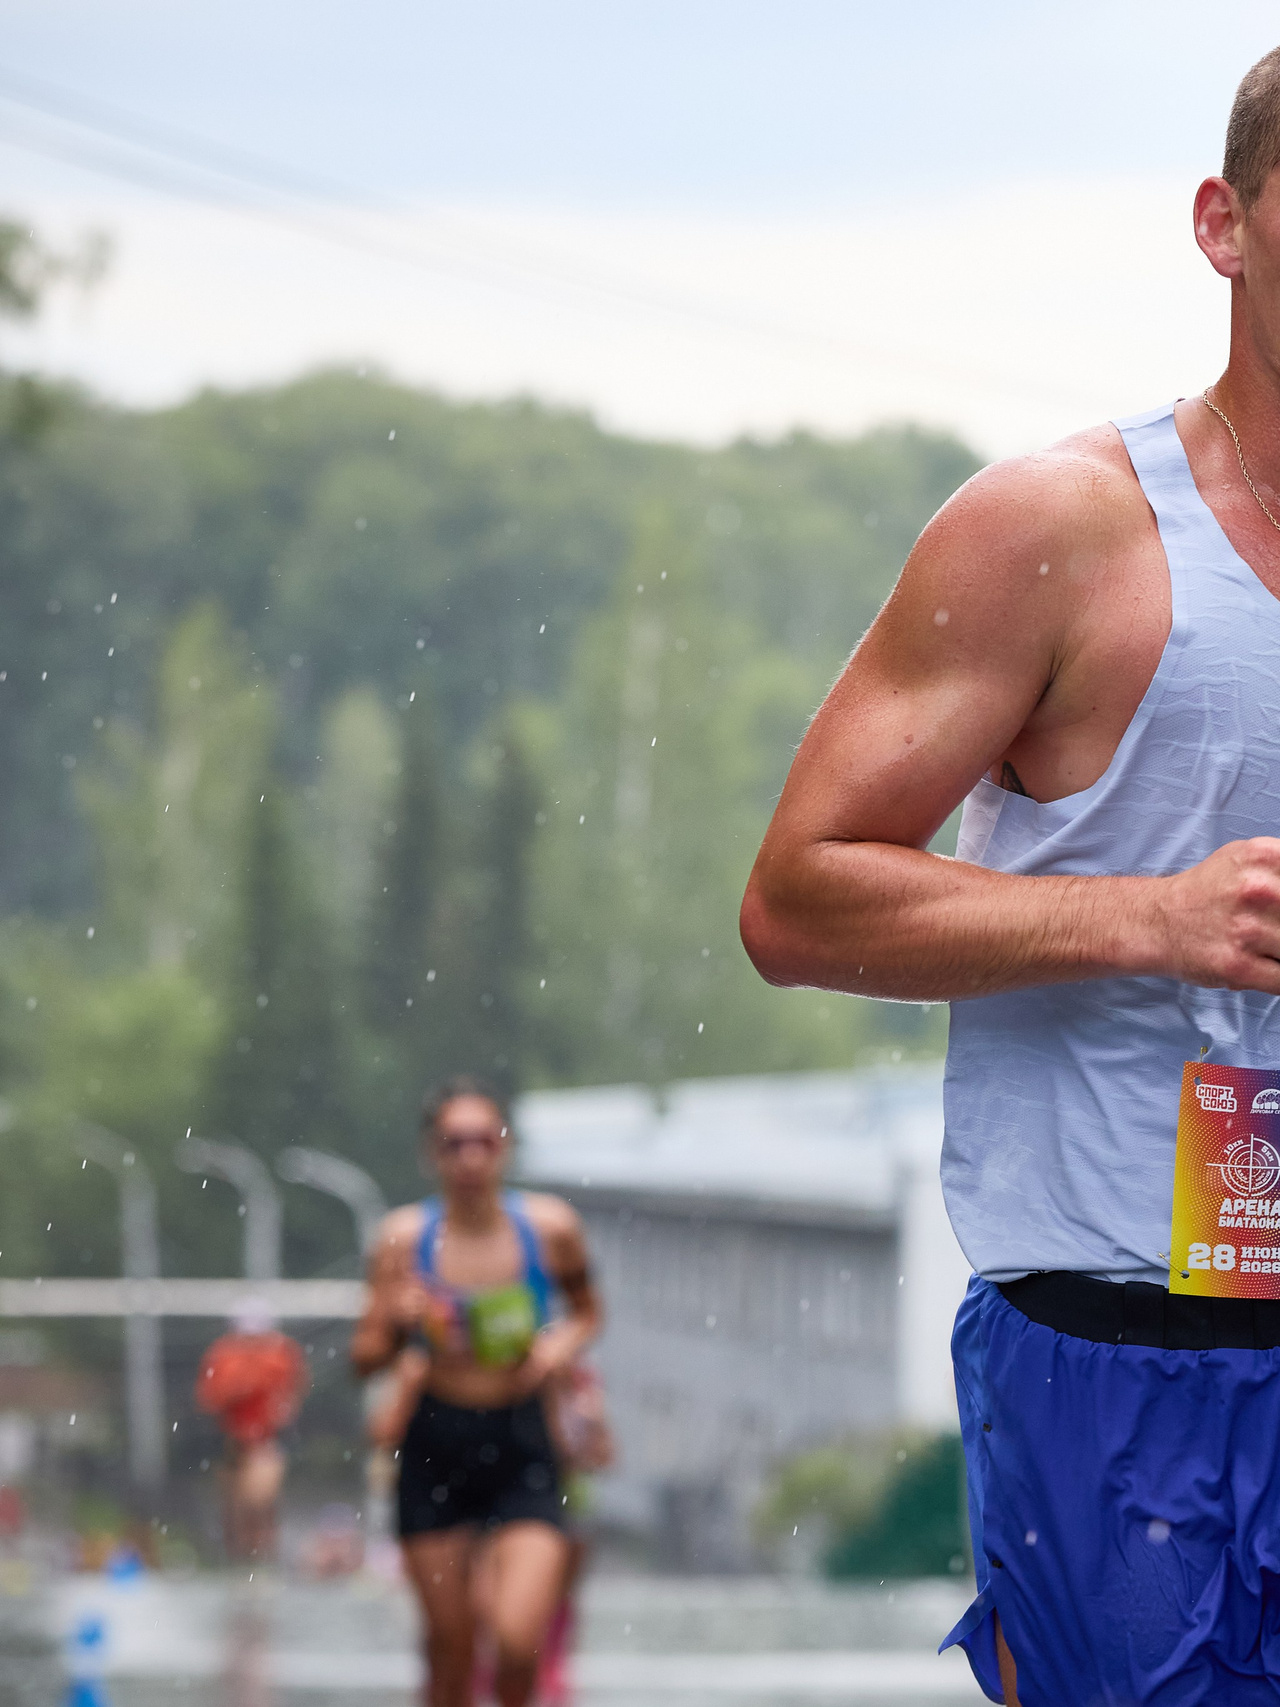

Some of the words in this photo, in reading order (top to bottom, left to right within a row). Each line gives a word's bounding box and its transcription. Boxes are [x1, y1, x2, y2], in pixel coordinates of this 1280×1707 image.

[1198, 1086, 1232, 1099] СПОРТ
[1203, 1098, 1235, 1110] СОЮЗ
[1187, 1242, 1236, 1271] 28
